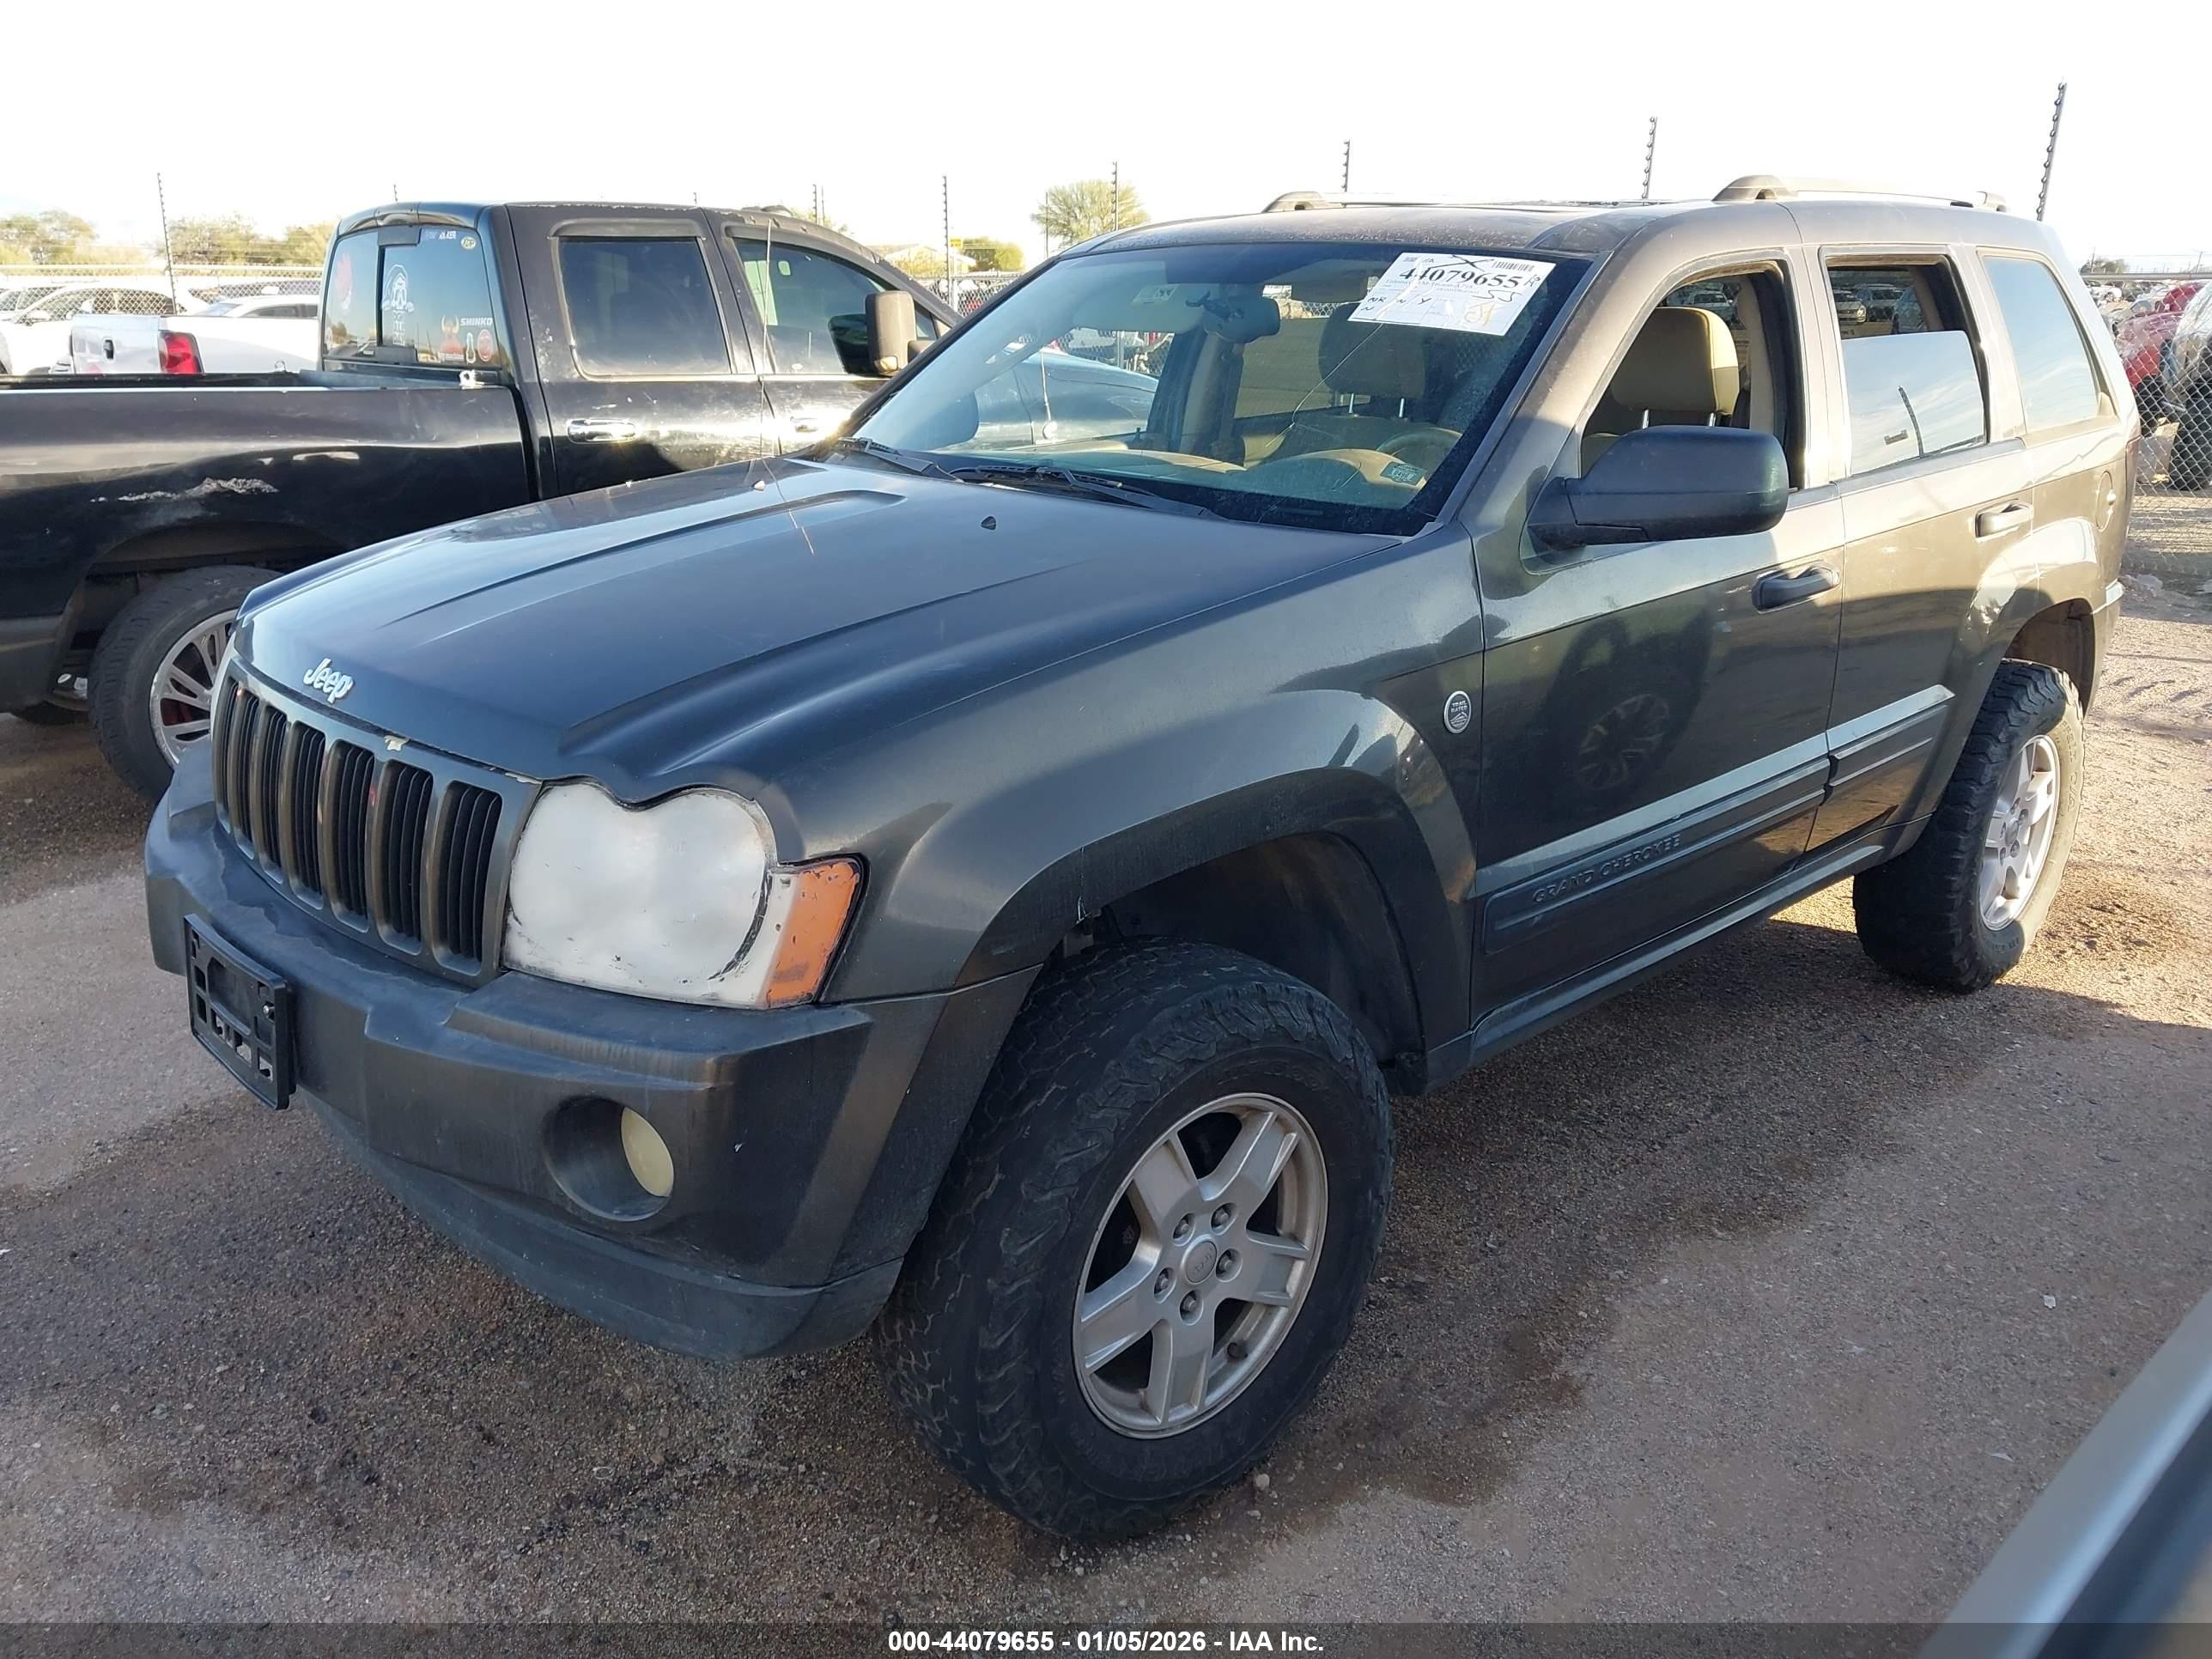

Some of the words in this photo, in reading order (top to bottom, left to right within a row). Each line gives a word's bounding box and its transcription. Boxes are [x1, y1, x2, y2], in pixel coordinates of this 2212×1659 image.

[459, 317, 494, 326] SHINKO
[302, 658, 354, 704] Jeep
[1531, 869, 1595, 902] GRAND
[1599, 833, 1682, 877] CHEROKEE
